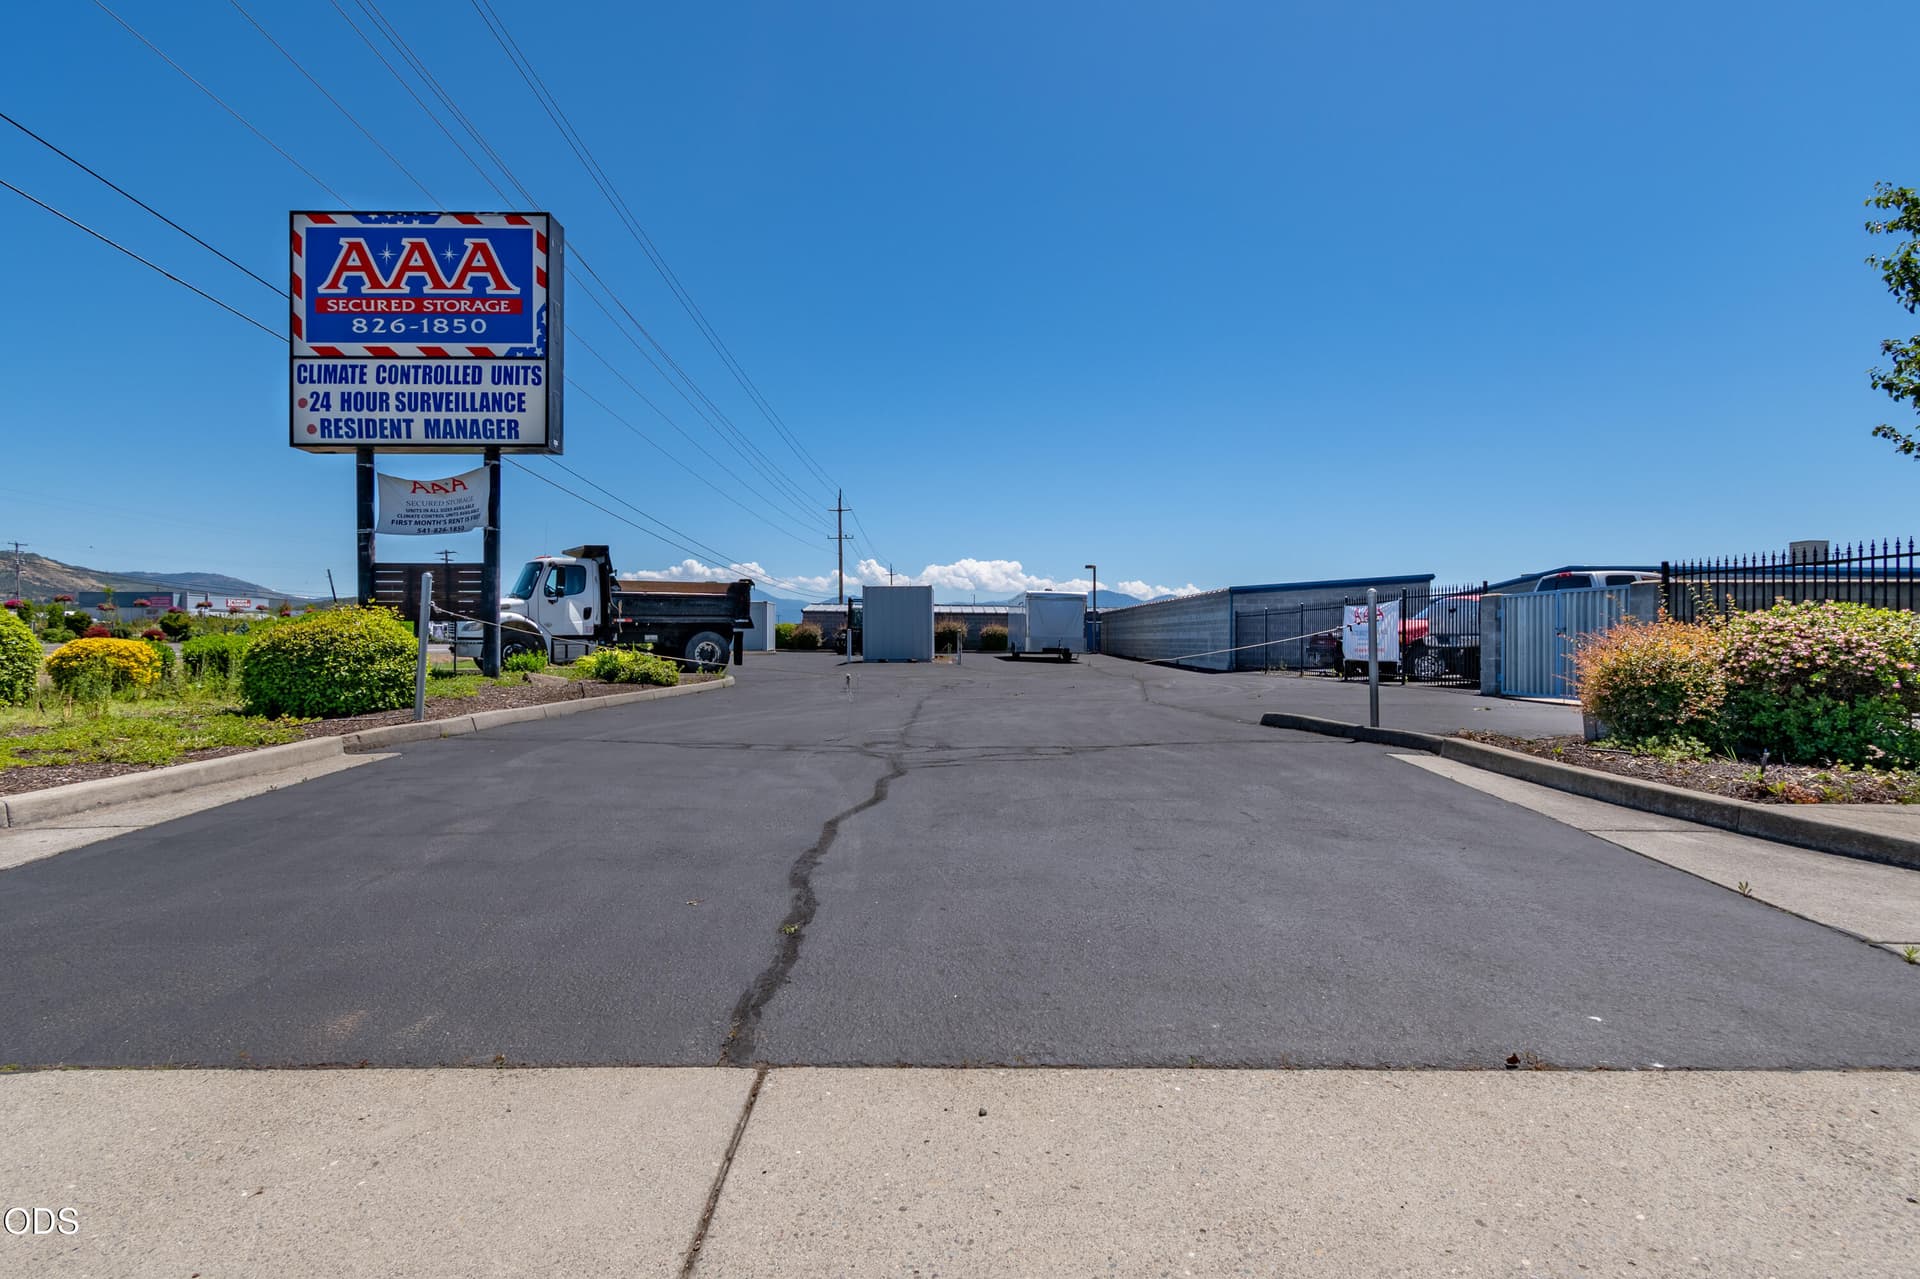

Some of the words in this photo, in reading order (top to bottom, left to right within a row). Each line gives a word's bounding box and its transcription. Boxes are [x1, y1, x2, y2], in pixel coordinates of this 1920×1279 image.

[317, 237, 521, 295] AAA
[327, 299, 416, 312] SECURED
[423, 299, 511, 312] STORAGE
[352, 318, 487, 334] 826-1850
[296, 364, 368, 386] CLIMATE
[375, 364, 483, 386] CONTROLLED
[491, 365, 542, 386] UNITS
[309, 391, 332, 412] 24
[340, 391, 390, 412] HOUR
[395, 391, 527, 413] SURVEILLANCE
[319, 417, 415, 440] RESIDENT
[423, 418, 520, 440] MANAGER
[411, 478, 468, 494] AAA
[446, 496, 474, 505] STORAGE
